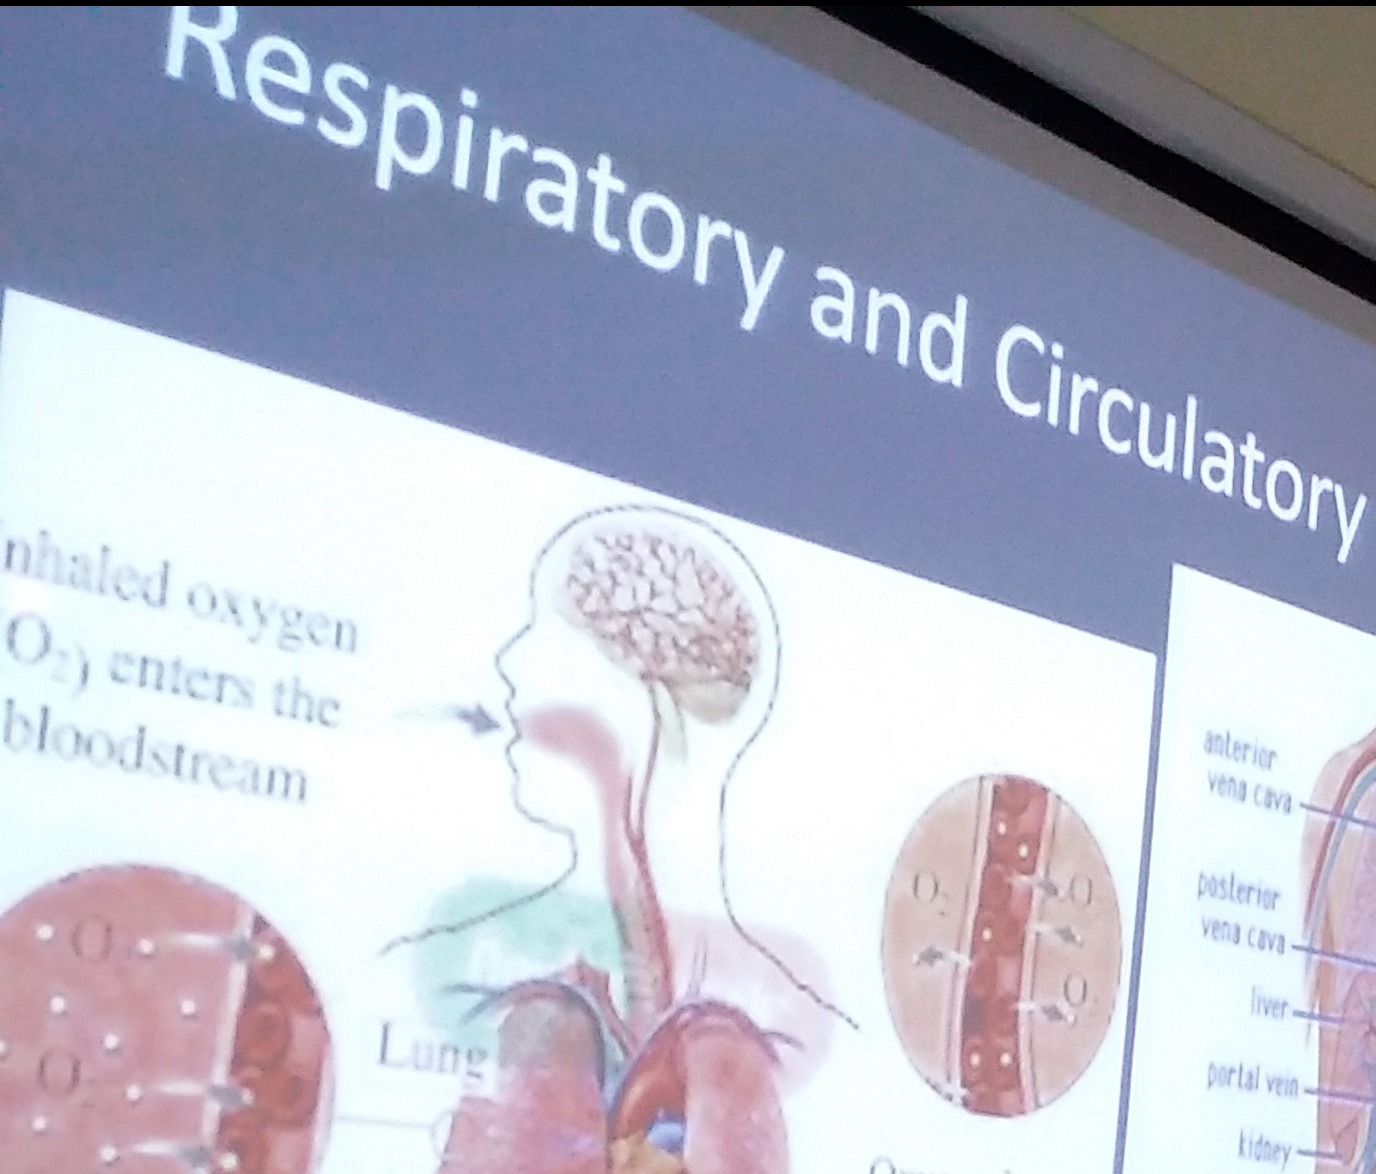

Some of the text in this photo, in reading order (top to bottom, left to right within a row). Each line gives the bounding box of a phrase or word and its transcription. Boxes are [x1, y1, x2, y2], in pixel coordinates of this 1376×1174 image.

[164, 6, 784, 331] Respiratory
[810, 265, 970, 388] and
[995, 324, 1368, 564] Circulatory
[0, 528, 358, 654] nhaled oxygen
[109, 649, 256, 709] enters
[273, 674, 341, 729] the
[2, 698, 307, 802] bloodstream
[1203, 729, 1278, 771] anterior
[1207, 771, 1293, 816] vena cava
[1198, 869, 1281, 912] posterior
[1202, 915, 1286, 956] vena cava
[1251, 985, 1289, 1020] liver
[378, 1021, 489, 1085] Lung
[1207, 1060, 1299, 1100] portal vein
[1238, 1129, 1293, 1173] kidney
